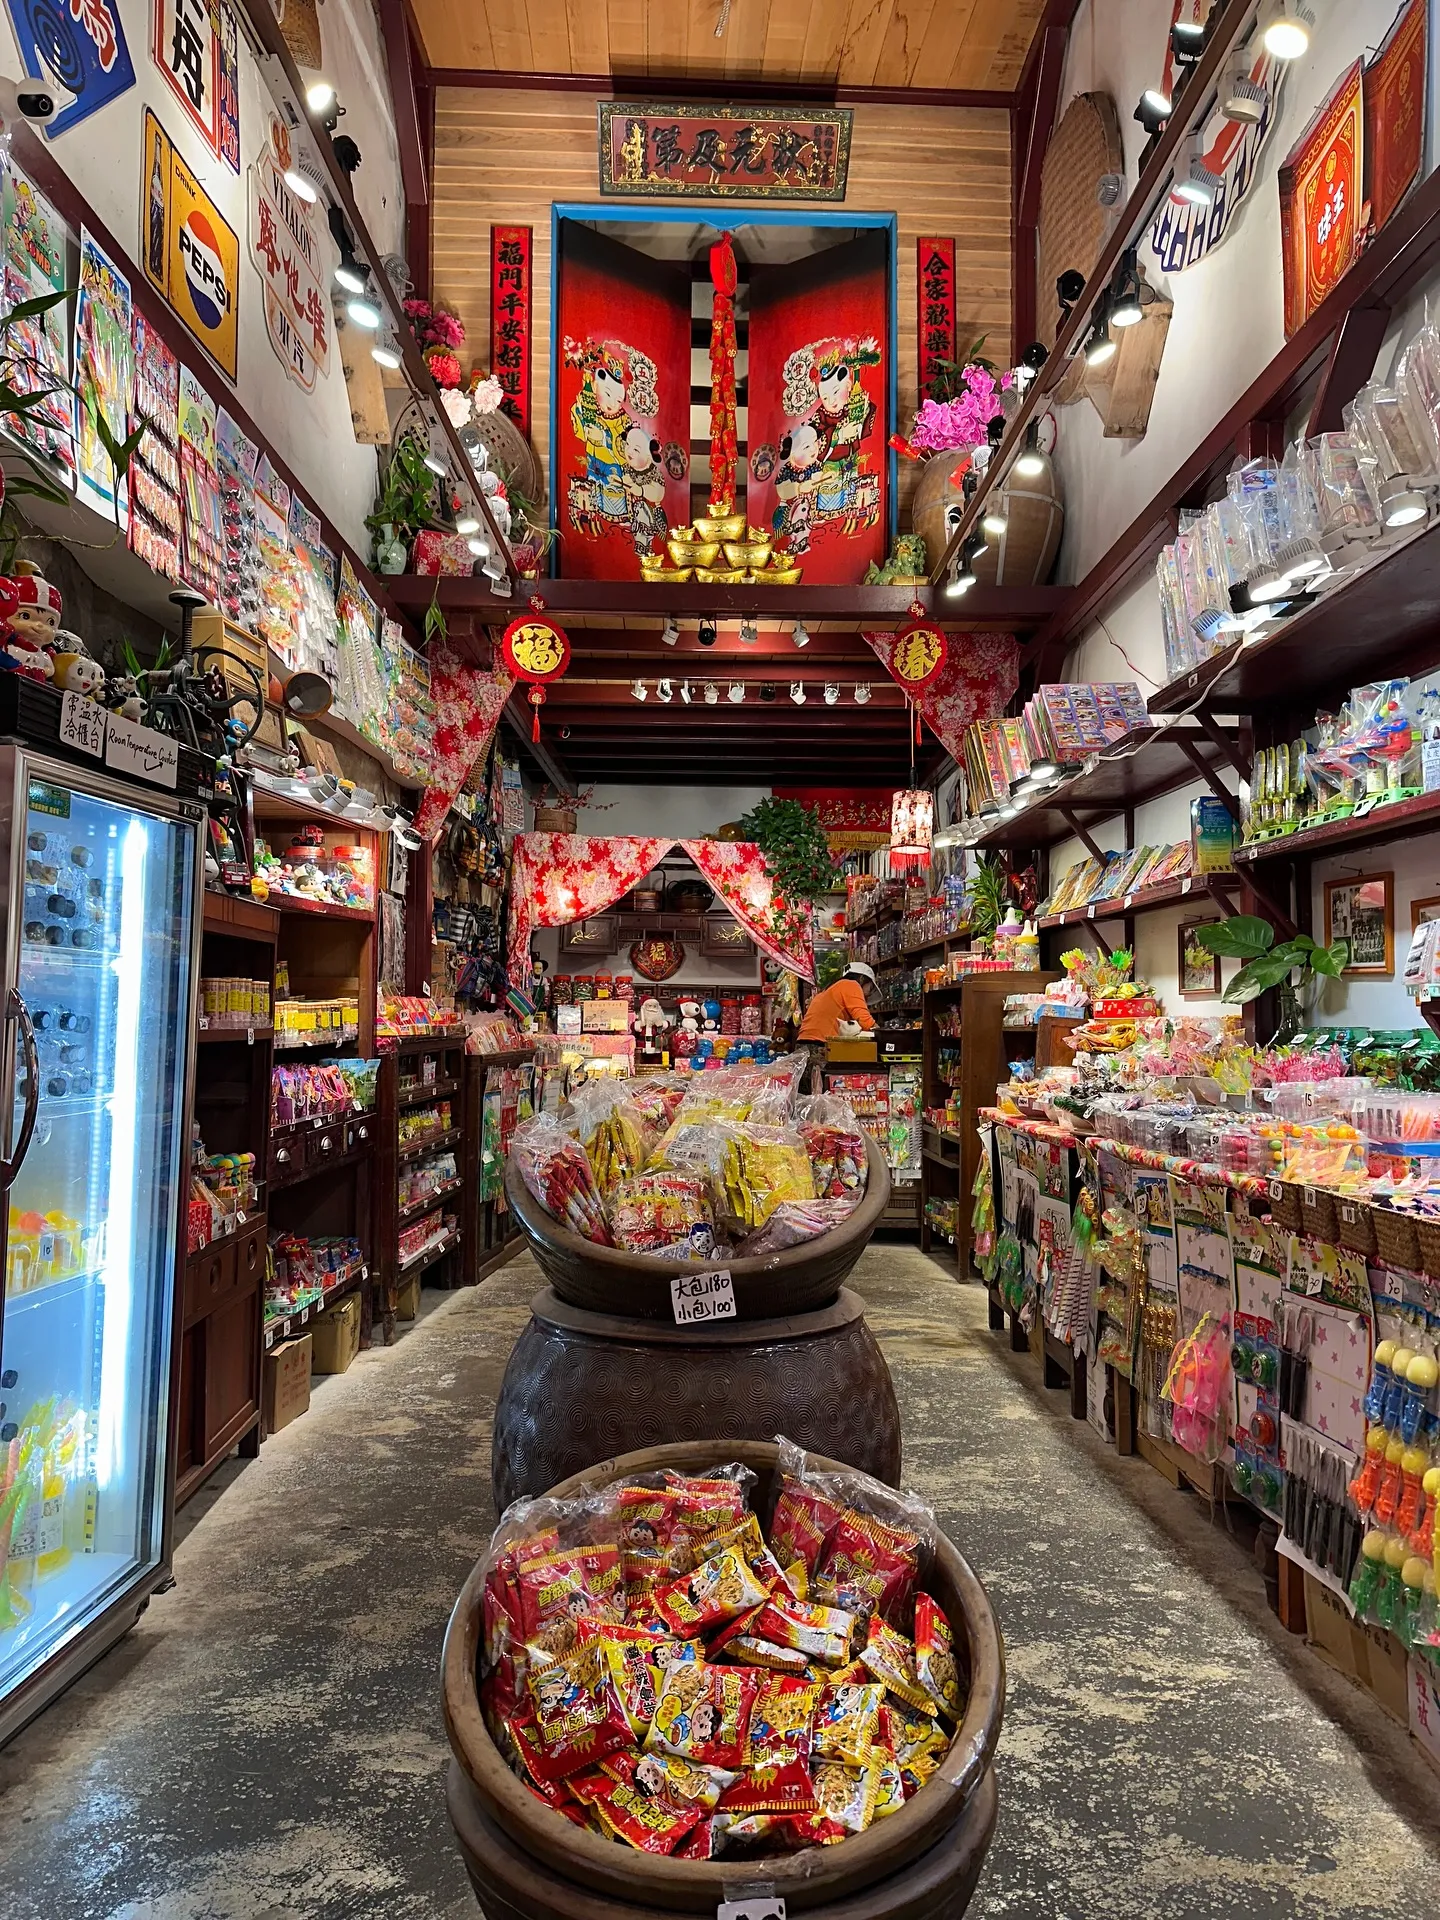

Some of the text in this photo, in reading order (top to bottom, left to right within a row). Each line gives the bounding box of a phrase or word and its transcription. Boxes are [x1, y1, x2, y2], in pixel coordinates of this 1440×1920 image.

[174, 165, 198, 201] DRINK
[271, 170, 313, 266] VITALON
[1316, 180, 1346, 244] 味王
[178, 225, 231, 315] PEPSI
[513, 627, 558, 672] 福
[902, 630, 936, 679] 春
[68, 694, 103, 727] 常溫水
[63, 717, 100, 752] 洽櫃台
[649, 942, 668, 962] 福
[1305, 1092, 1312, 1107] 15
[1211, 1135, 1219, 1145] 50
[1272, 1185, 1279, 1197] 15
[1388, 1276, 1401, 1295] 30
[843, 1526, 861, 1543] JN
[831, 1551, 888, 1599] 牛肉麵
[542, 1703, 608, 1746] 牛肉麵
